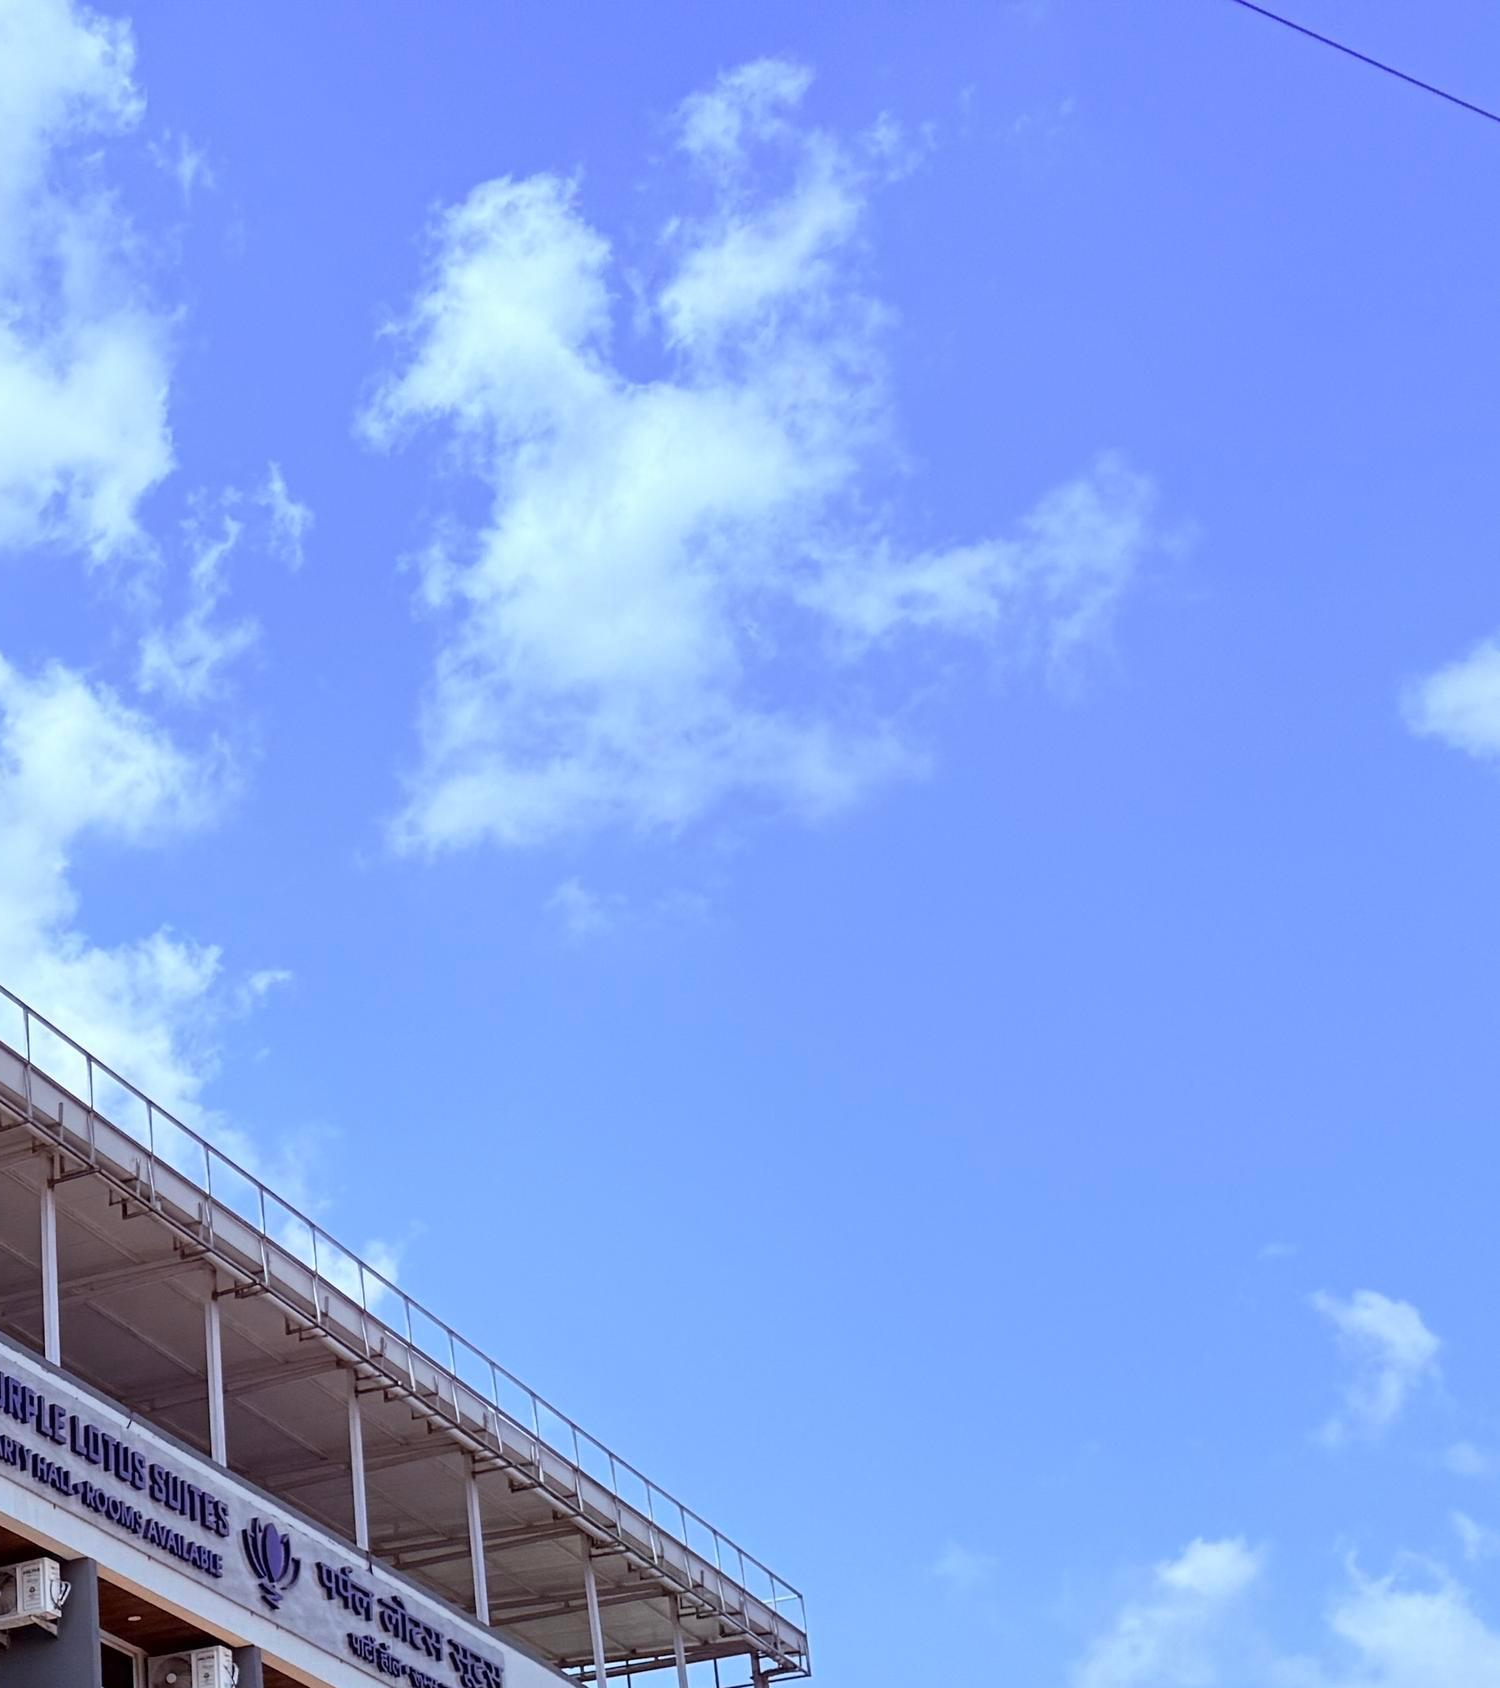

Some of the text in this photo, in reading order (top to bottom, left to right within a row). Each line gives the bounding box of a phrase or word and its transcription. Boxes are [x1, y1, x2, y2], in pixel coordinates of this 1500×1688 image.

[31, 1453, 73, 1497] HALL
[142, 1518, 224, 1578] AVAILABLE
[69, 1415, 148, 1491] LOTUS
[149, 1463, 231, 1538] SUITES
[315, 1561, 375, 1622] पर्पल
[376, 1595, 444, 1662] लोटस
